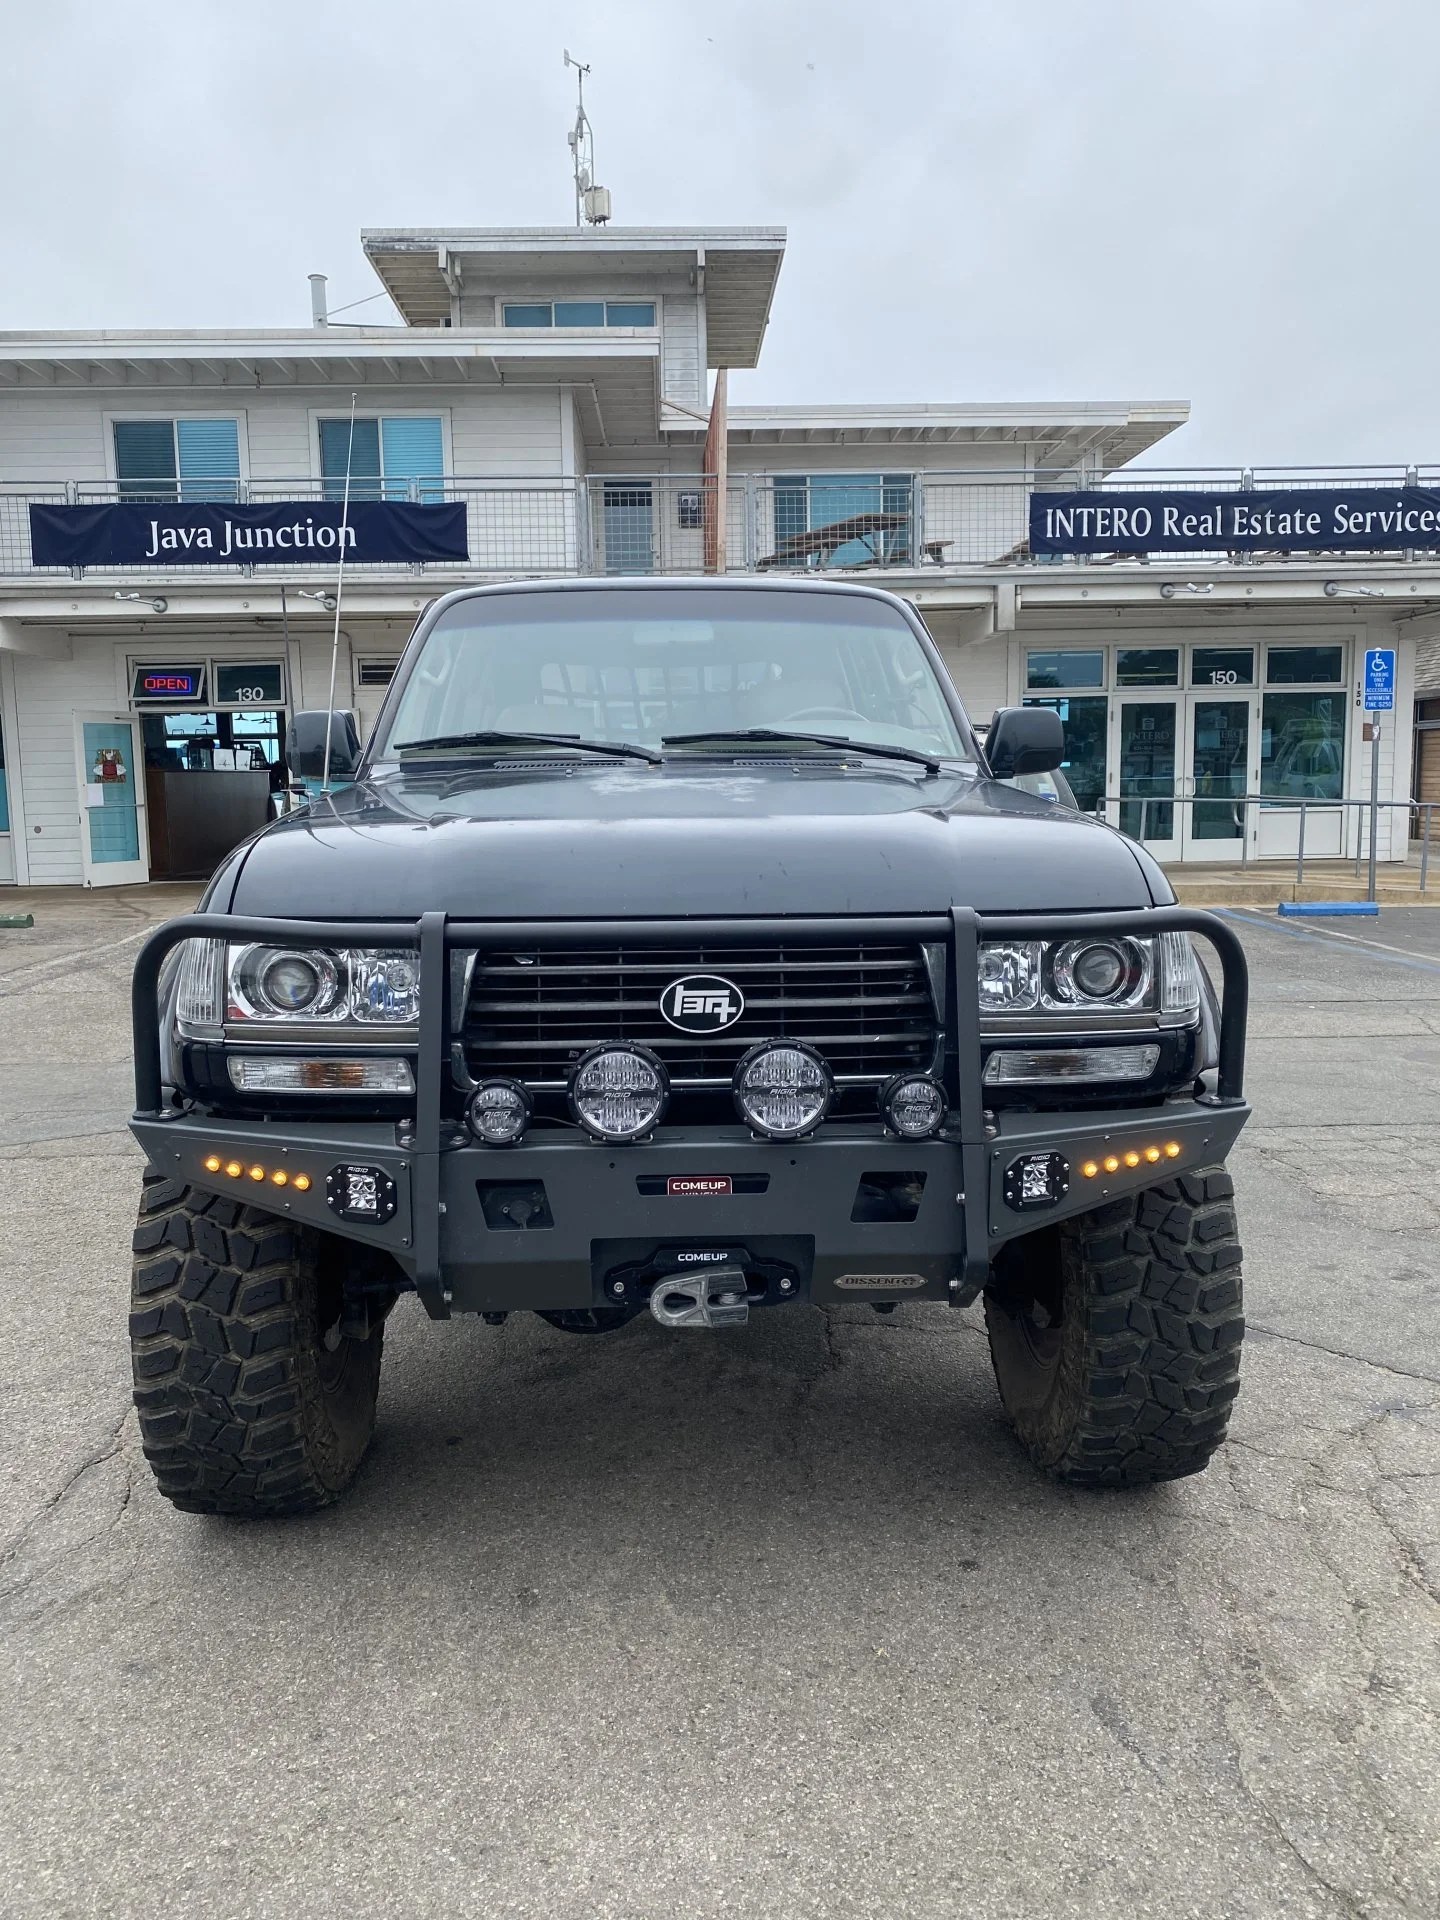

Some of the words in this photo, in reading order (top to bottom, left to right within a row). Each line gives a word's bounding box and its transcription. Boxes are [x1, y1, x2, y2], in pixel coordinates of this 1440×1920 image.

[1046, 507, 1152, 538] INTERO
[1163, 505, 1222, 537] Real
[1233, 506, 1321, 536] Estate
[145, 520, 213, 557] Java
[219, 518, 357, 556] Junction
[144, 678, 188, 690] OPEN
[1209, 670, 1237, 685] 150
[234, 687, 264, 701] 130
[1128, 731, 1169, 740] INTERO
[672, 1181, 727, 1190] COMEUP
[677, 1253, 728, 1262] COMEUP
